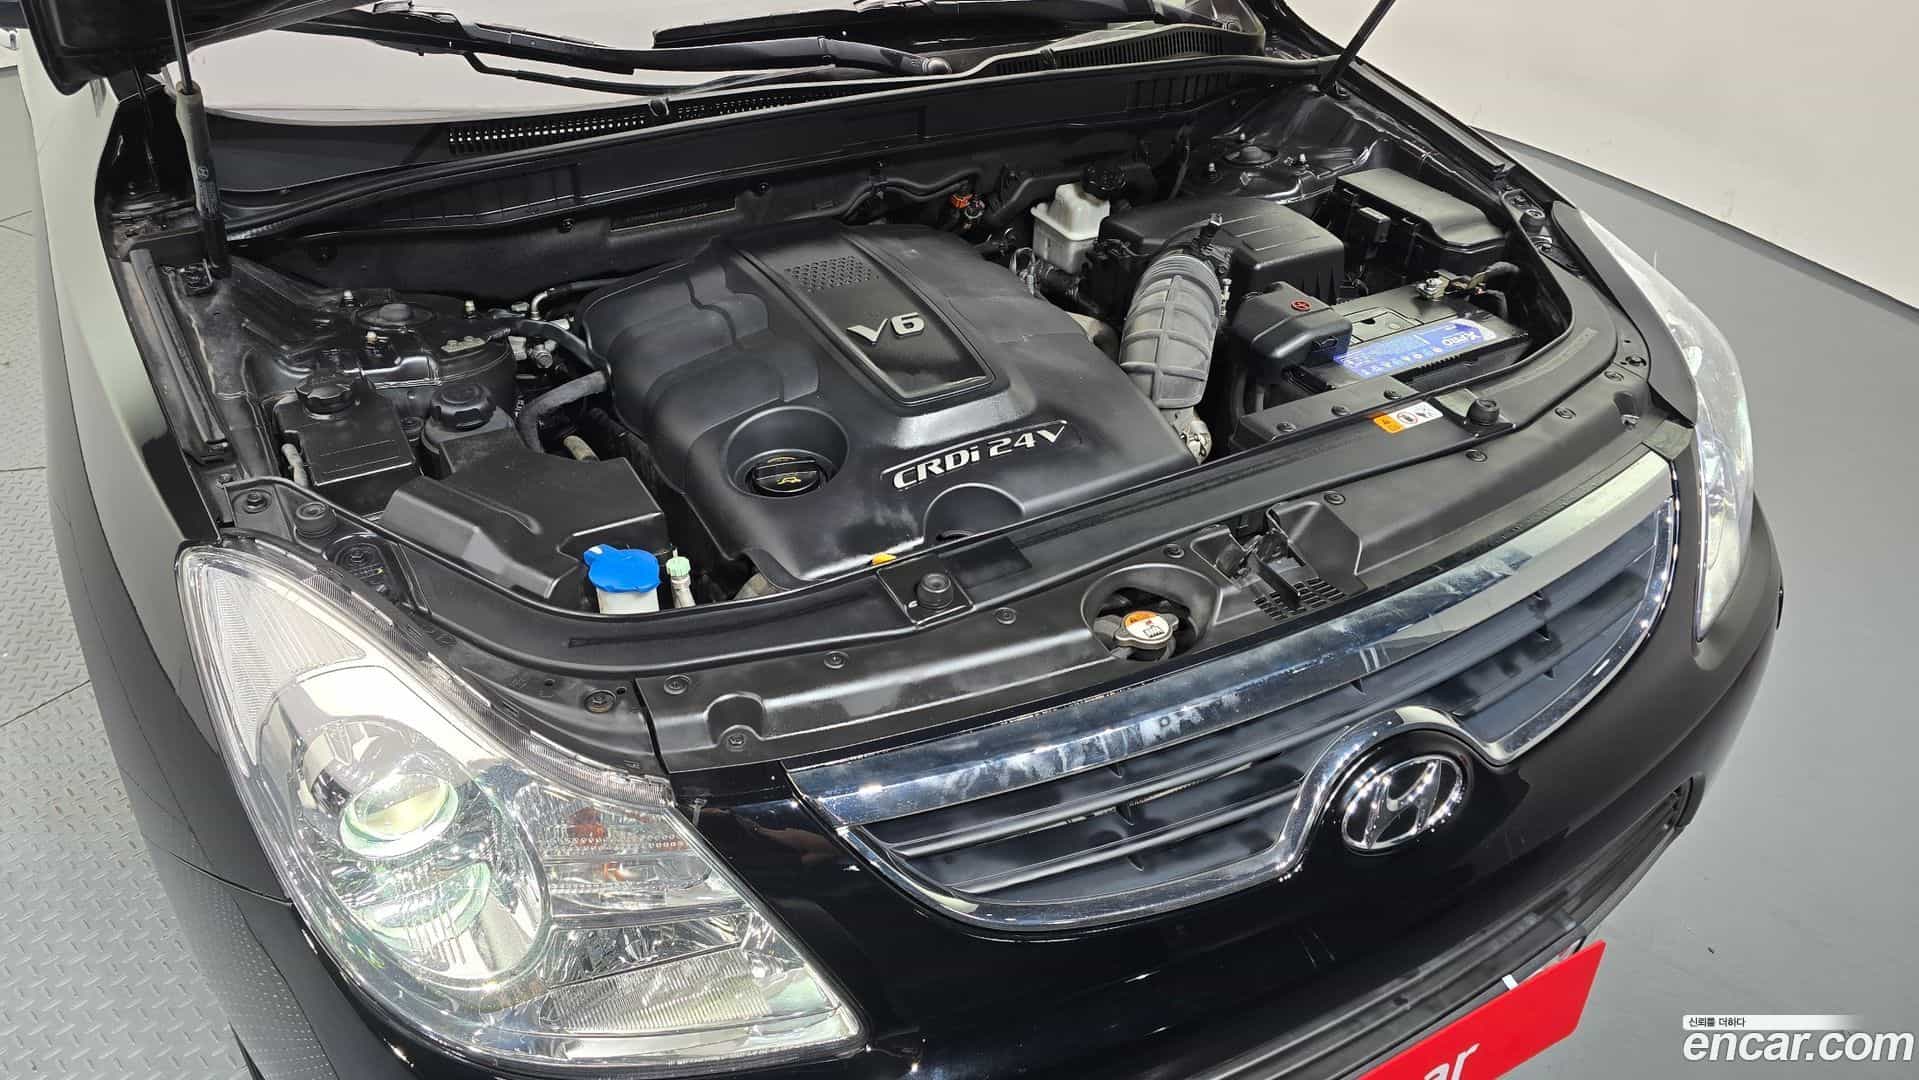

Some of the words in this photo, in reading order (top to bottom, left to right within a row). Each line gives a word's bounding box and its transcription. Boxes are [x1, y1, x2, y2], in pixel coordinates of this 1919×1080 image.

[847, 312, 925, 344] V6
[893, 445, 981, 490] CRDi
[987, 425, 1066, 457] 24V
